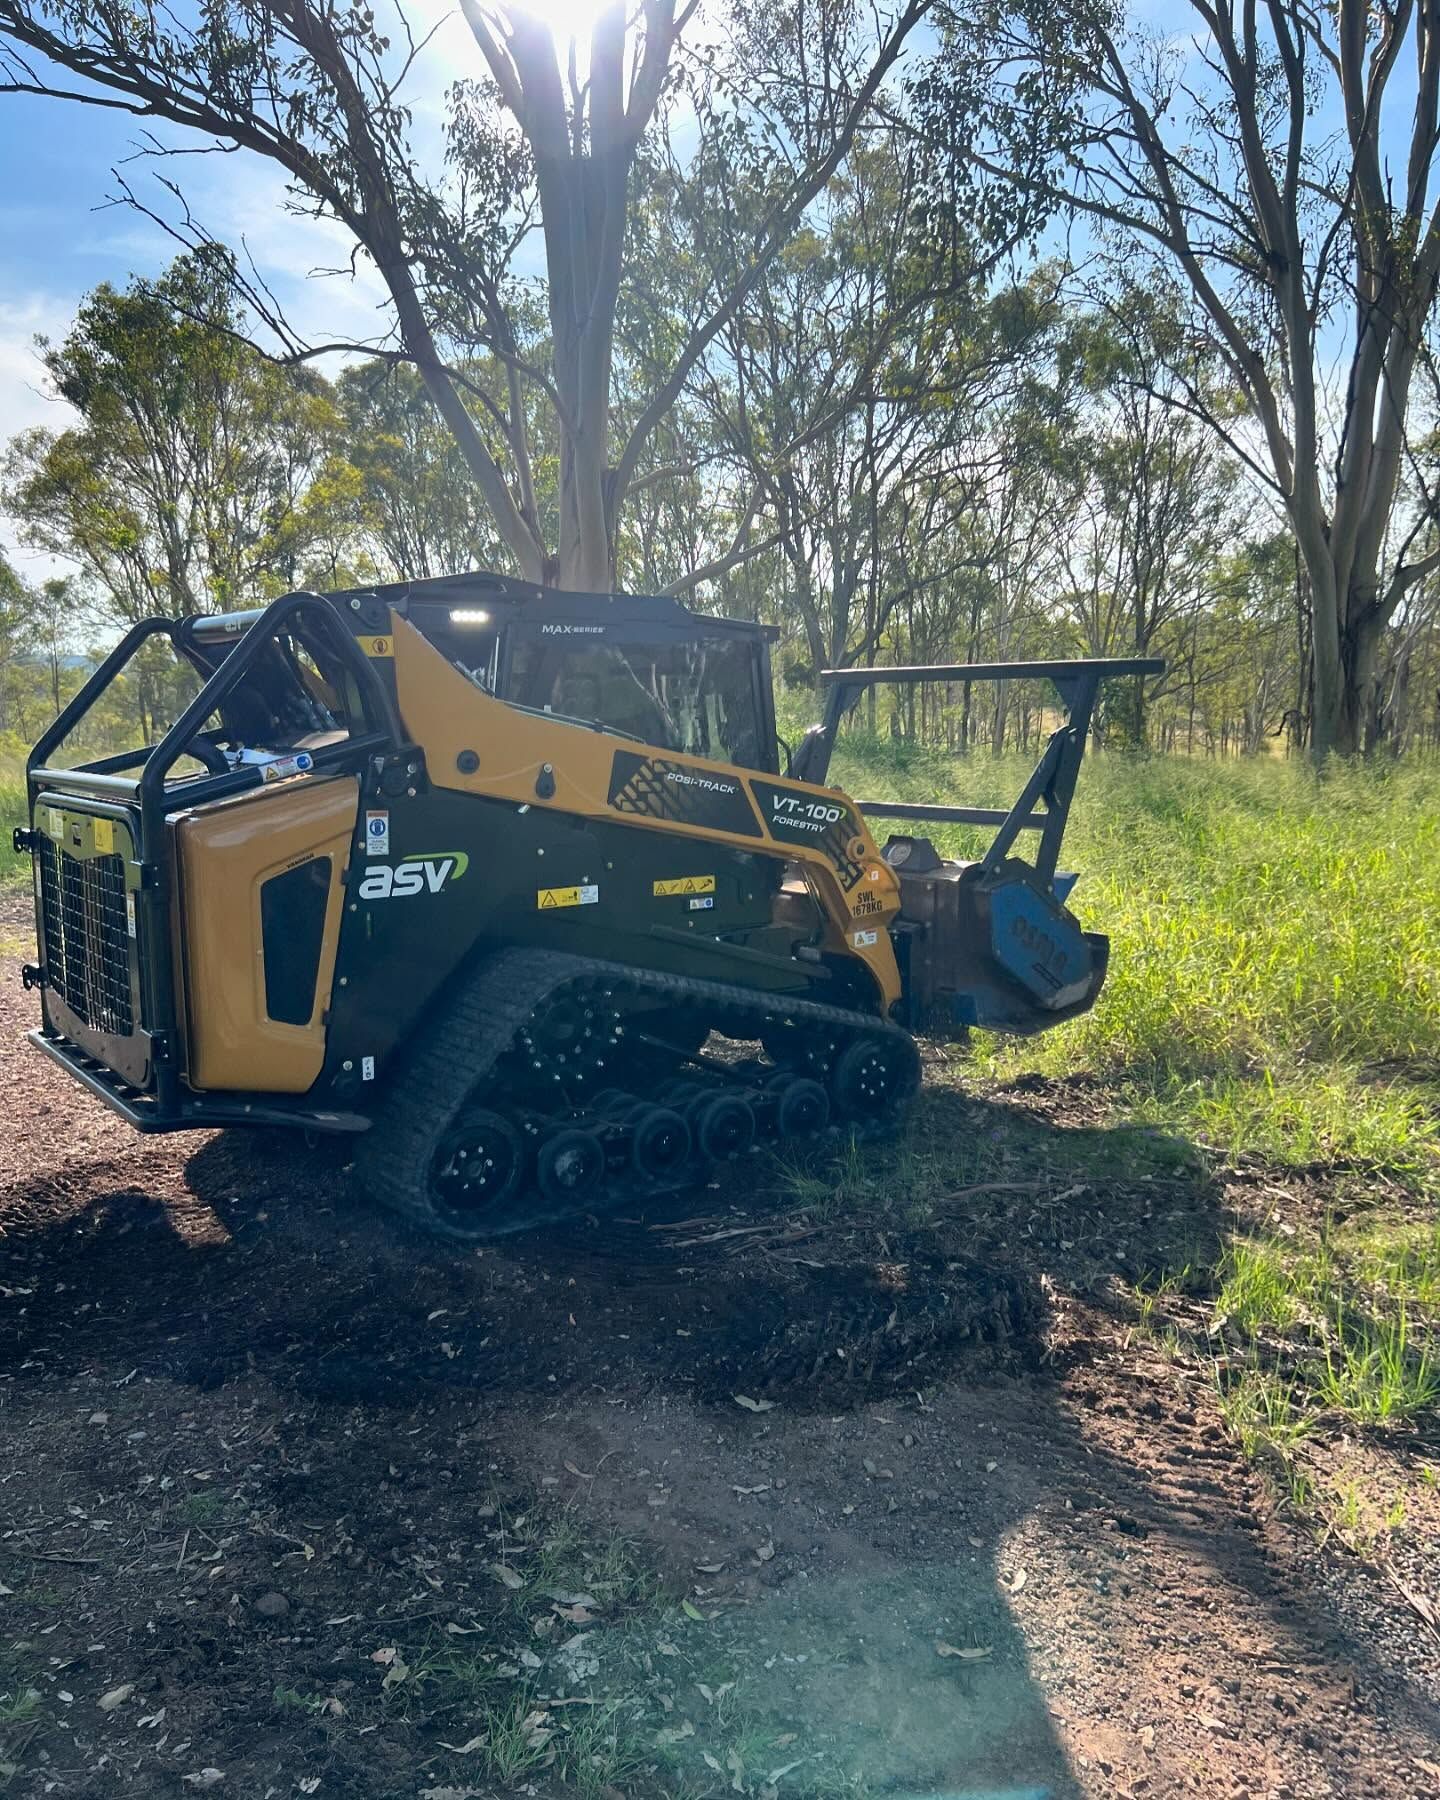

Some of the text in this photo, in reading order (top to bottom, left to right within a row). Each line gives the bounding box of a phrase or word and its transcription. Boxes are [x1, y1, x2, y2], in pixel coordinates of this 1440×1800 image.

[667, 772, 736, 795] POSI-TRACK
[772, 795, 840, 823] VT-100
[772, 815, 827, 834] FORESTRY
[857, 890, 876, 904] SWL
[852, 900, 883, 917] 1678KG
